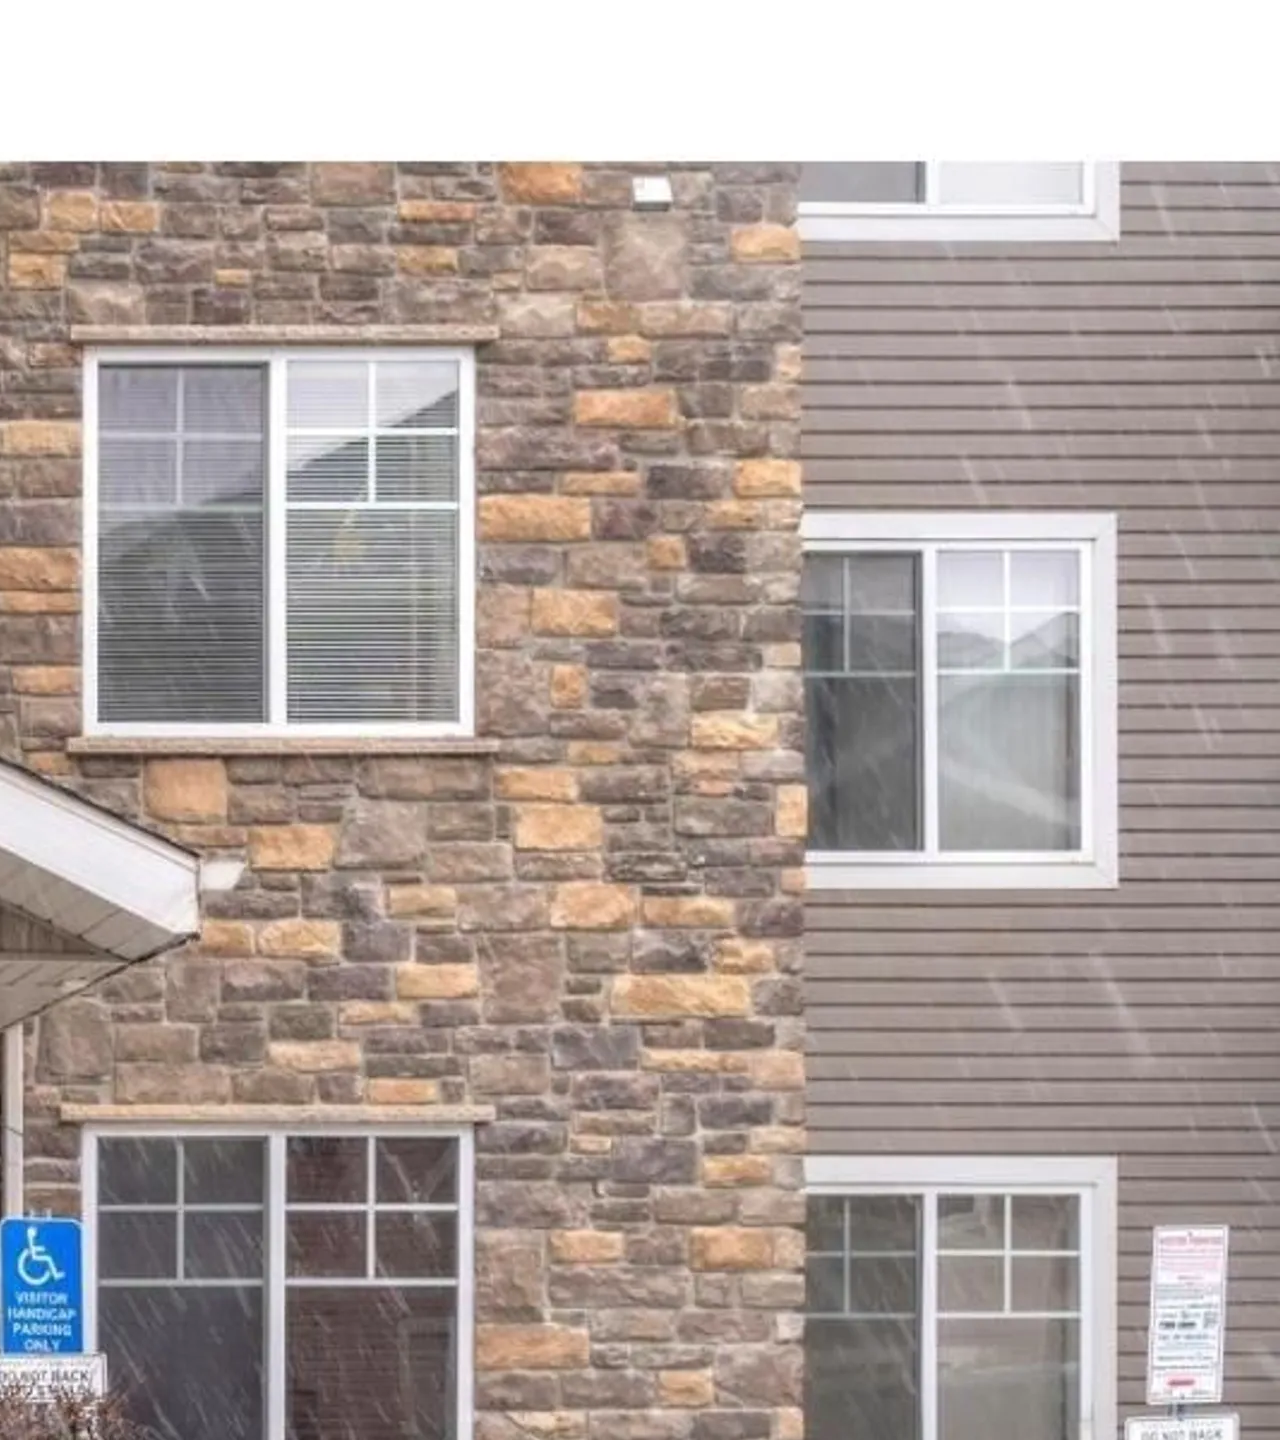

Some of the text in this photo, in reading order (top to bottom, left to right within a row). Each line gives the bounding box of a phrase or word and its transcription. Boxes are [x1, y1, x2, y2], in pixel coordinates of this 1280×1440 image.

[15, 1291, 68, 1305] VISITOR
[7, 1307, 77, 1321] HANDICAP
[13, 1323, 72, 1336] PARKING
[23, 1339, 61, 1352] ONLY
[51, 1369, 90, 1382] BACK
[1162, 1429, 1186, 1440] NOT
